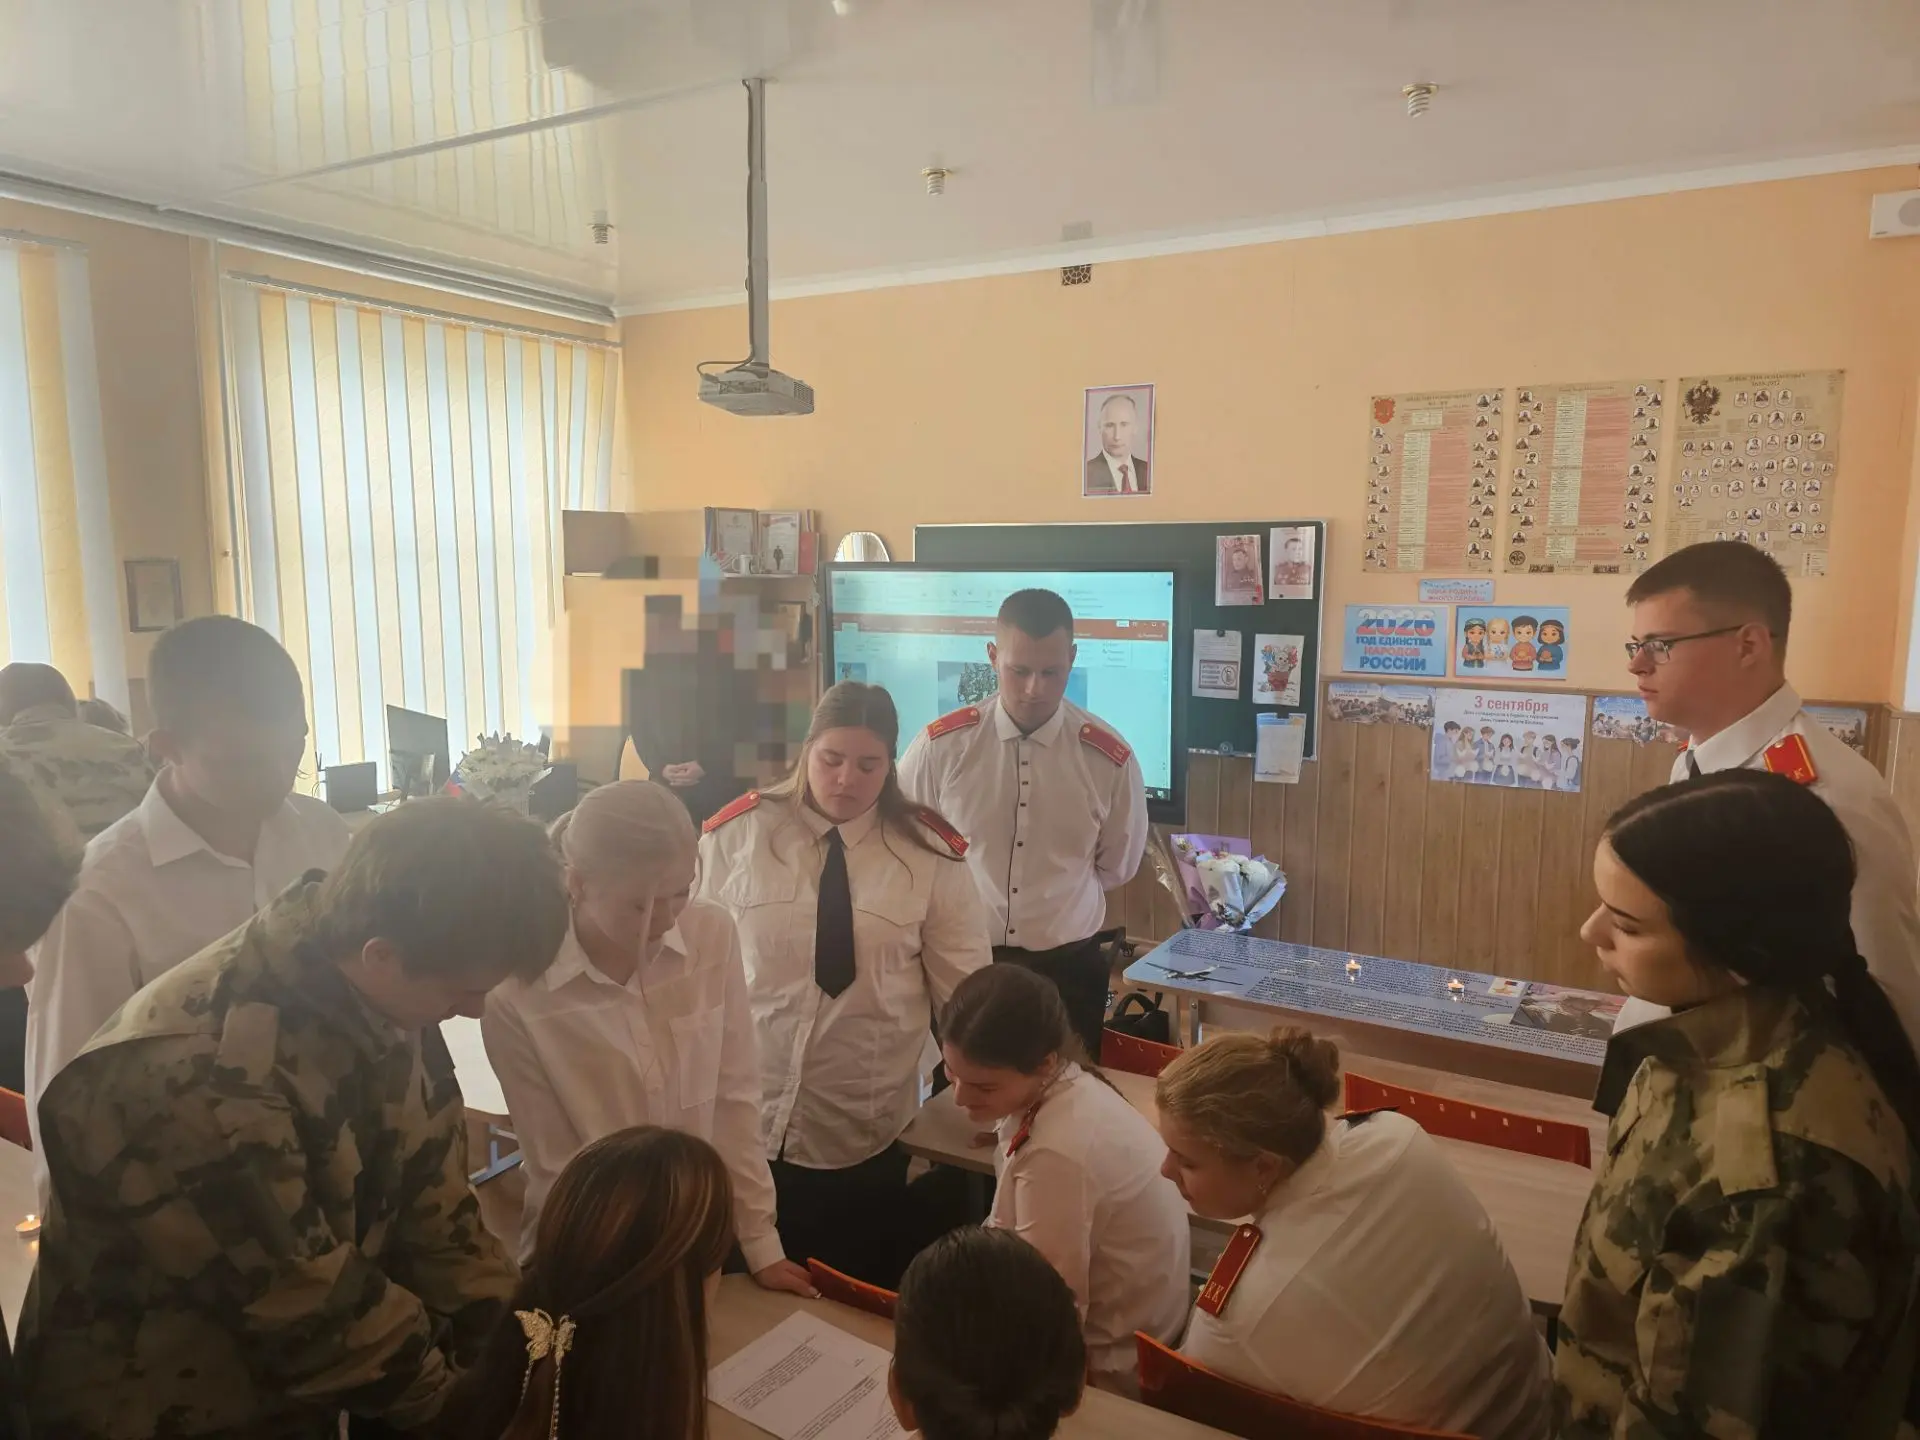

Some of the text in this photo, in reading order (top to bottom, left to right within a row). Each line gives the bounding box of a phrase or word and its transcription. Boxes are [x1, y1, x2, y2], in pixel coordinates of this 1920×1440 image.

[1356, 608, 1435, 636] 2026
[1356, 636, 1433, 646] ГОД ЕДИНСТВА
[1364, 646, 1420, 656] НАРОДОВ
[1360, 656, 1426, 671] РОССИИ
[1474, 695, 1549, 714] 3 сентября
[1205, 1281, 1225, 1303] КК
